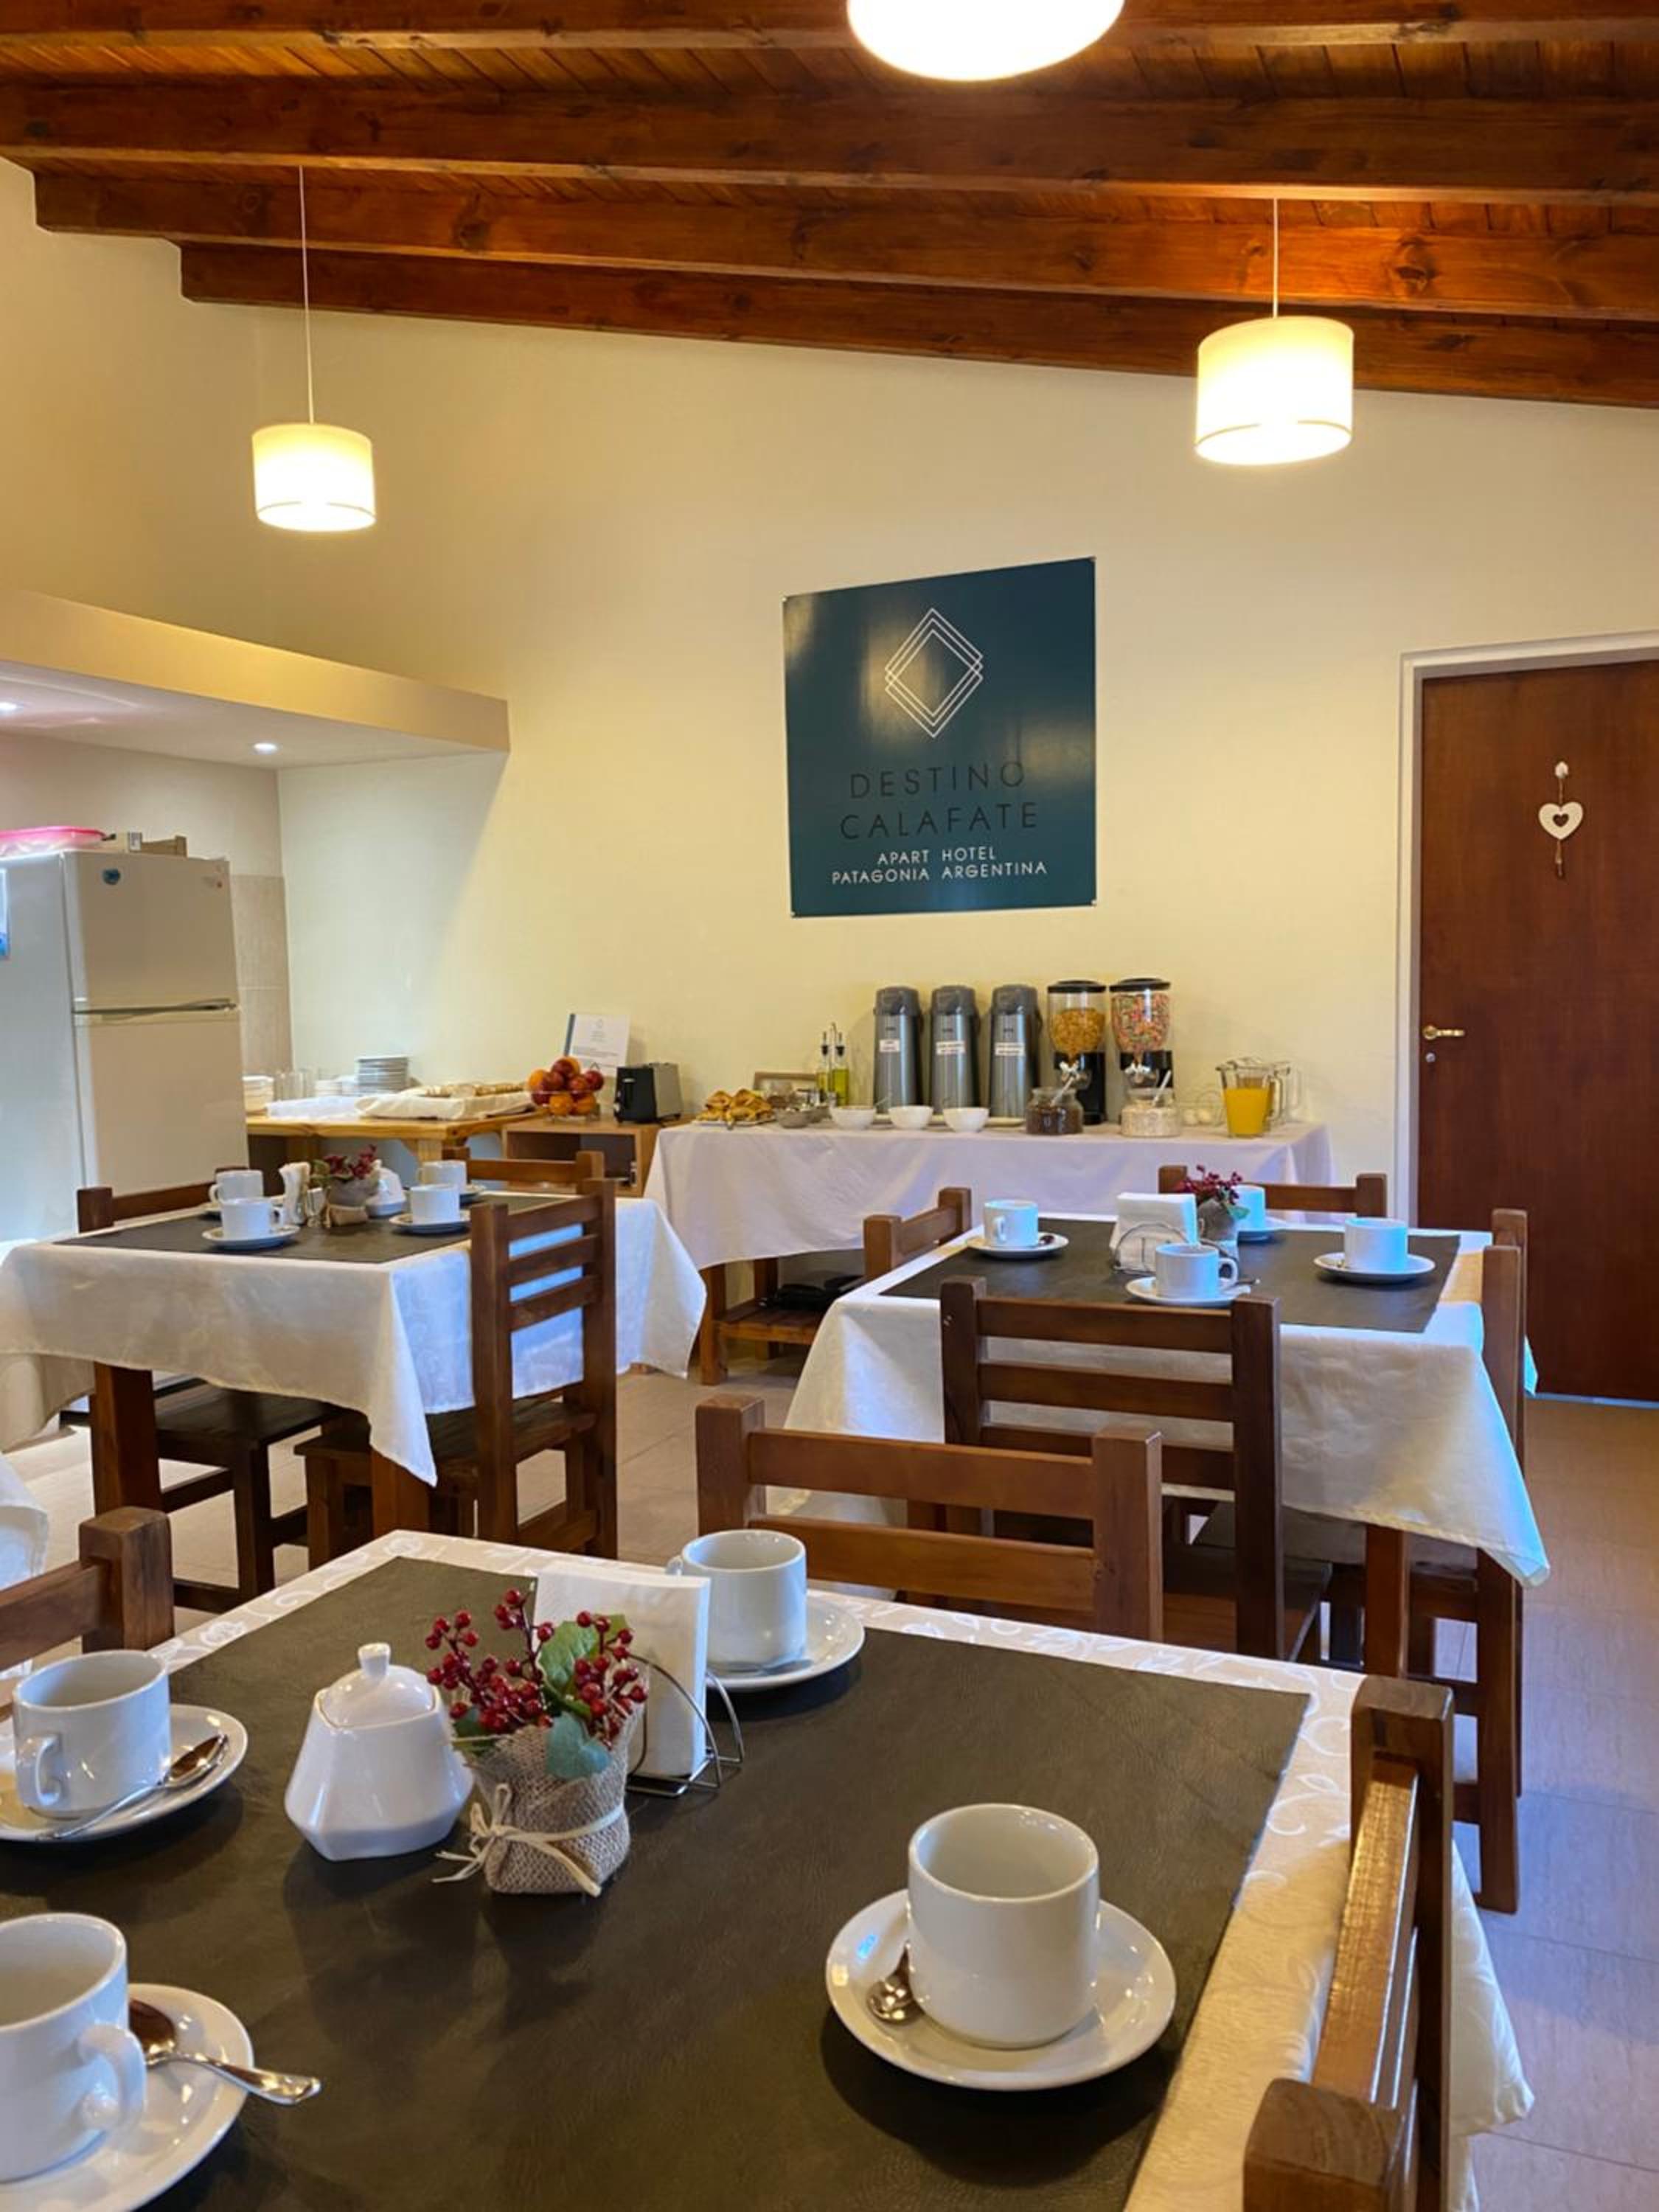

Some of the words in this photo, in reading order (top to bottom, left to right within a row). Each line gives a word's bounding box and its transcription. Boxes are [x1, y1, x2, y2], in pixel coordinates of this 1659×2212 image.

[850, 761, 1025, 799] DESTINO
[841, 801, 1037, 839] CALAFATE
[877, 849, 929, 865] APART
[942, 846, 996, 861] HOTEL
[832, 868, 930, 884] PATAGONIA
[942, 862, 1048, 879] ARGENTINA
